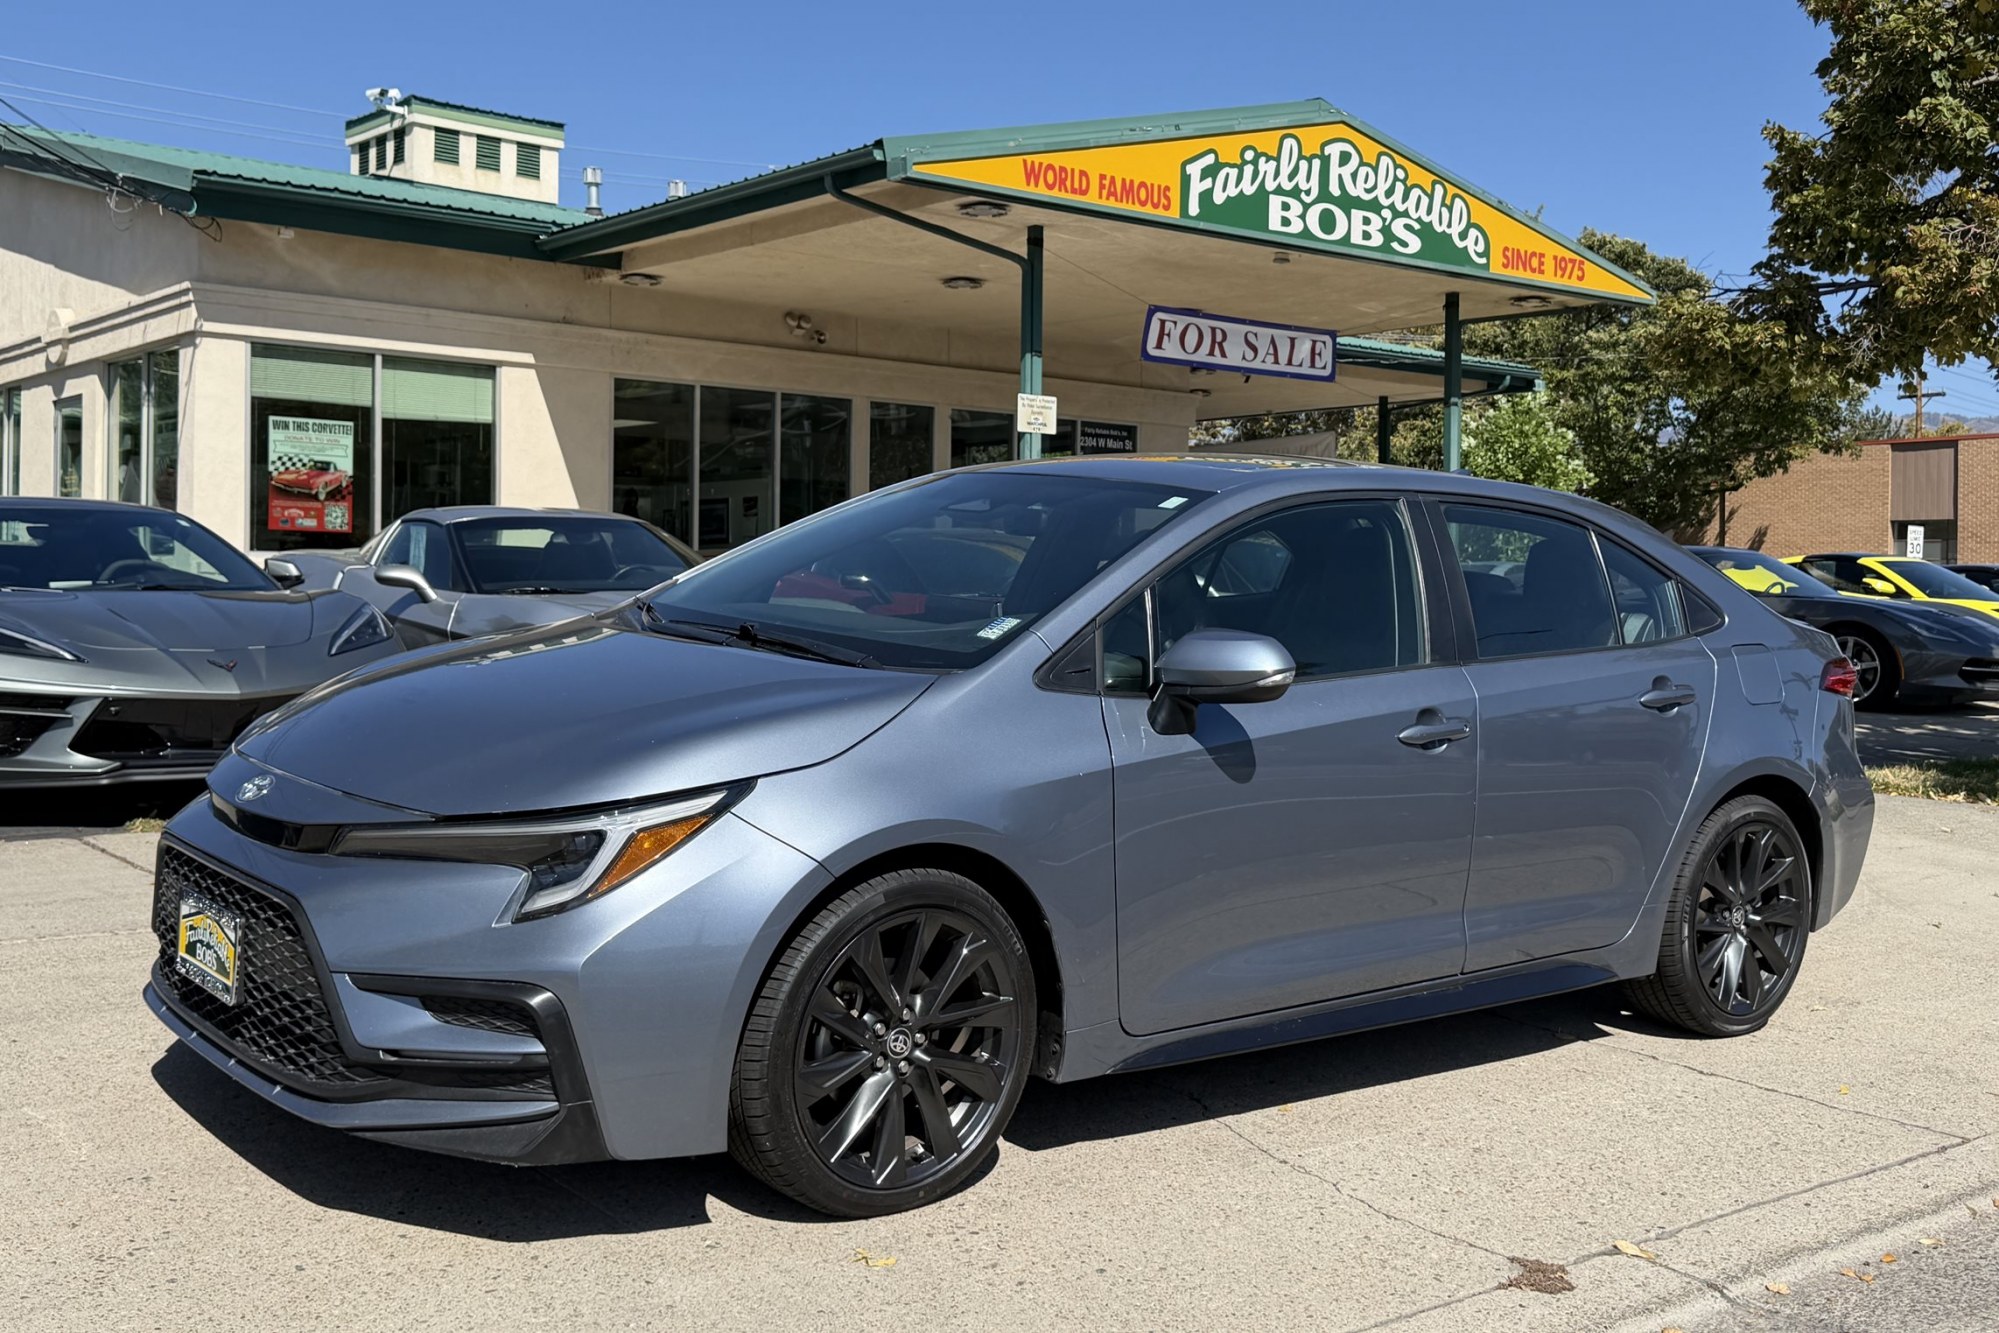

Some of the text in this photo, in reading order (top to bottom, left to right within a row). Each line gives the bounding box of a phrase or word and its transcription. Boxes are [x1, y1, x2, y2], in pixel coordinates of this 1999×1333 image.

[1022, 158, 1172, 212] WORLD FAMOUS
[1185, 137, 1488, 265] Fairly Reliable
[1268, 193, 1422, 255] BOB'S
[1501, 245, 1586, 282] SINCE 1975
[1152, 317, 1328, 370] FOR SALE
[272, 419, 352, 435] WIN THIS CORVETTE!
[1080, 436, 1133, 451] 2304 W Main St
[1909, 542, 1922, 554] 30
[196, 942, 217, 971] BOB'S
